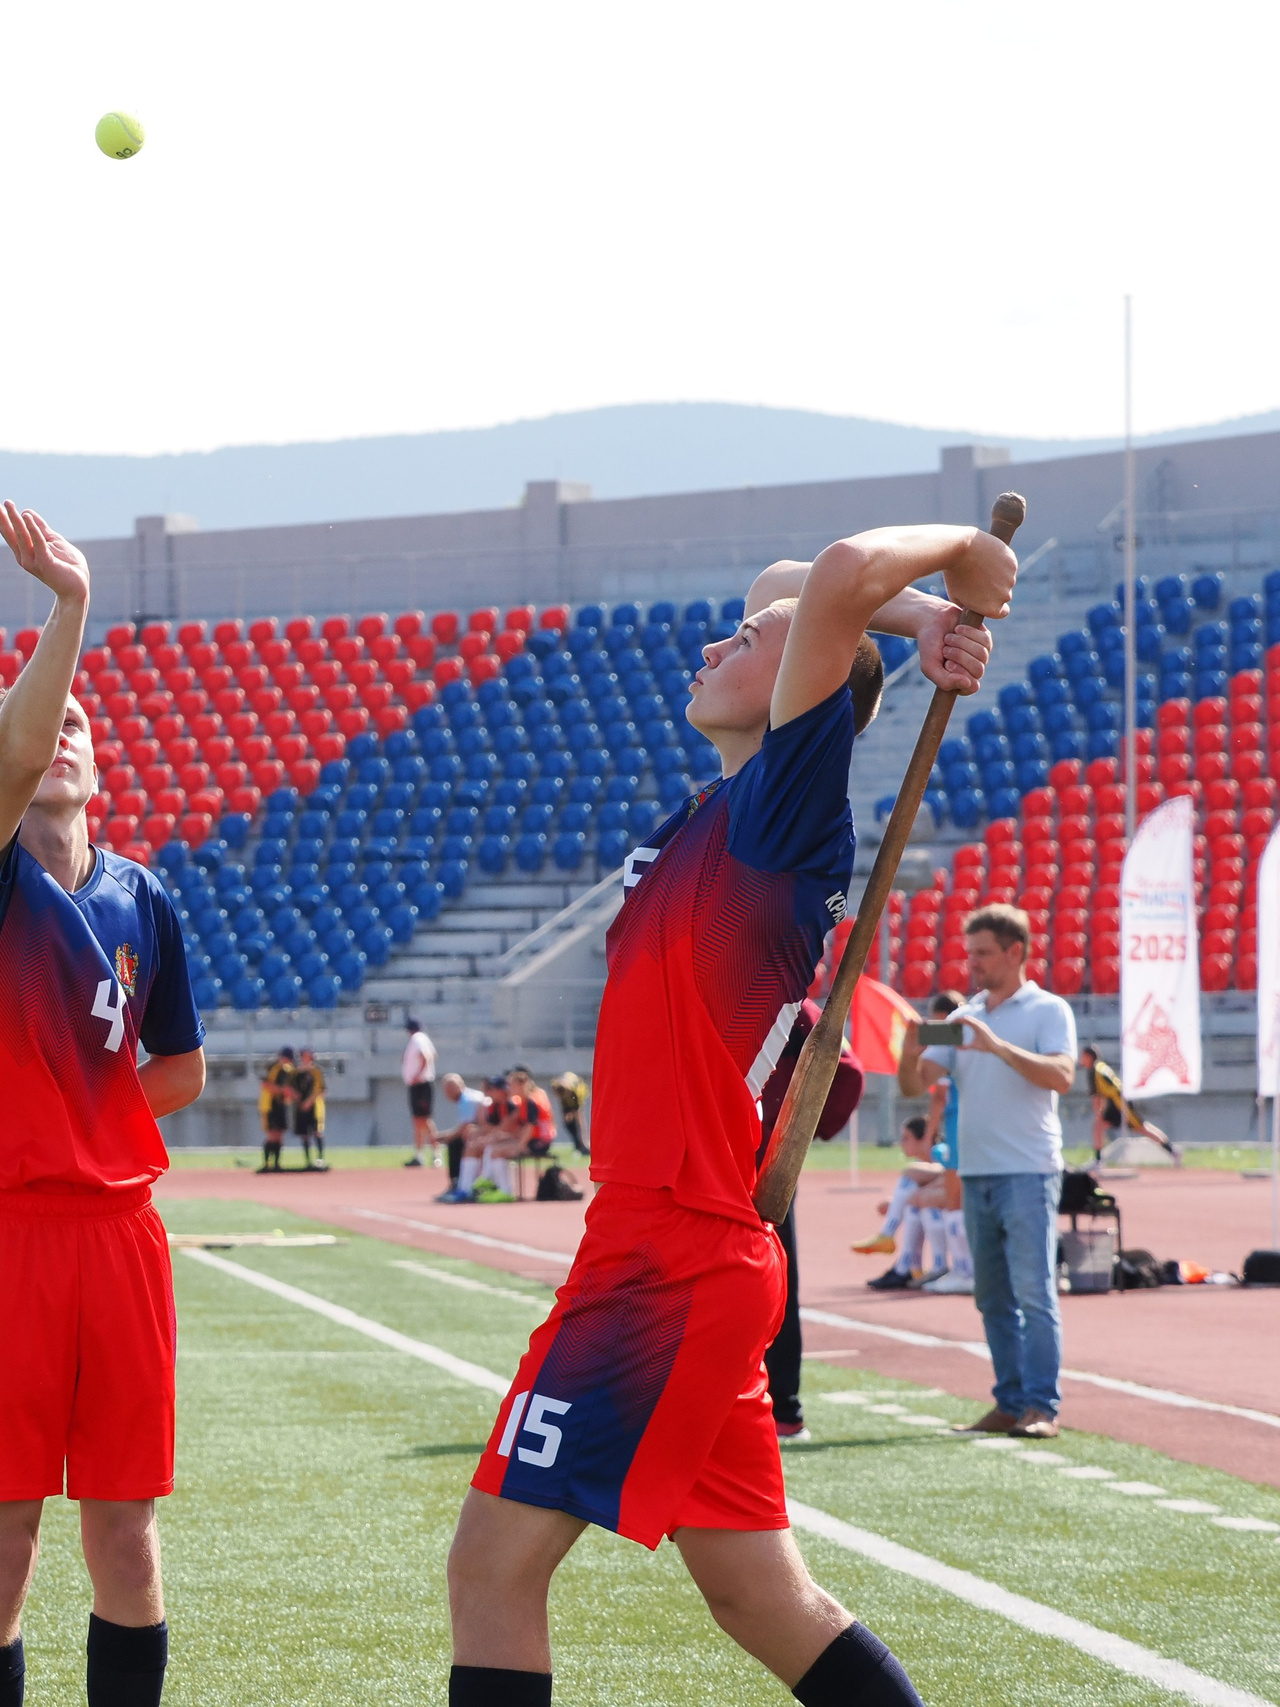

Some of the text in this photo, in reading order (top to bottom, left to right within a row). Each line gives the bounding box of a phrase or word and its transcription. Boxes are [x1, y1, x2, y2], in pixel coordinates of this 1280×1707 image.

[1130, 935, 1187, 961] 2025
[91, 978, 127, 1053] 4
[497, 1390, 572, 1468] 15
